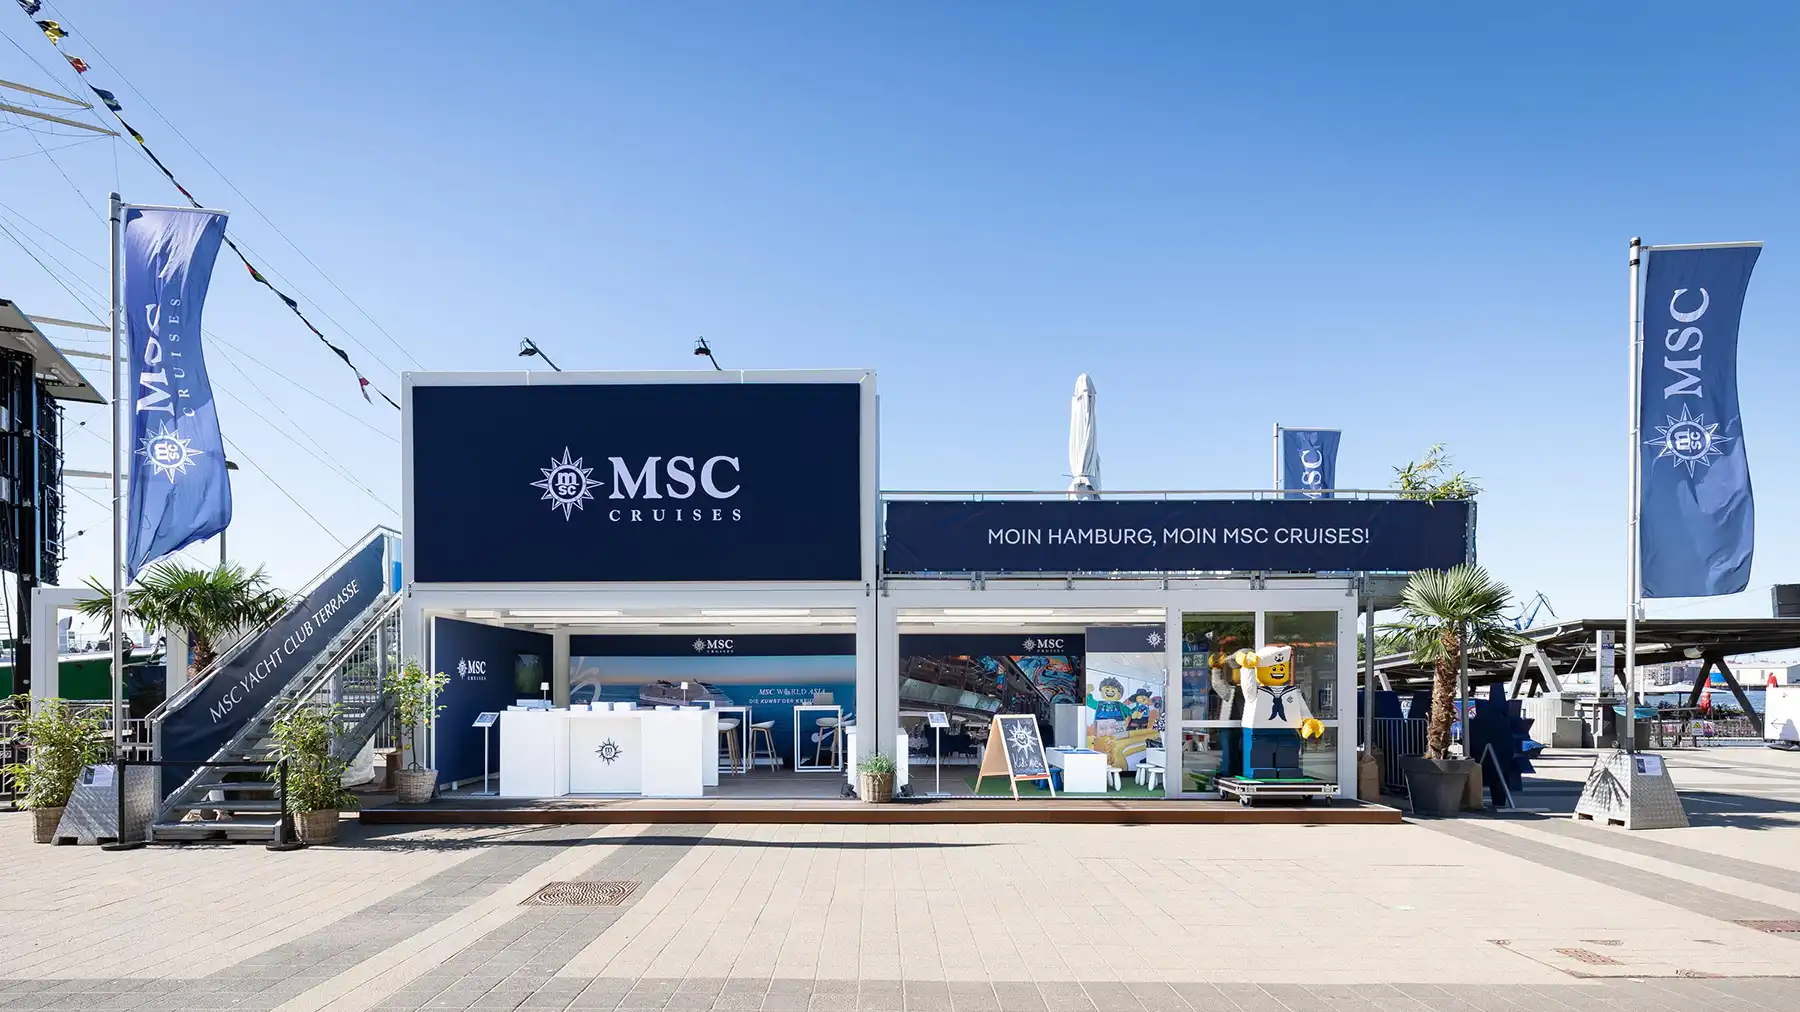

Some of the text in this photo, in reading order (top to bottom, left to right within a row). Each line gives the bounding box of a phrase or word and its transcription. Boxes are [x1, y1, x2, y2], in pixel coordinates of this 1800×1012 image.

[1664, 287, 1710, 399] MSC
[168, 298, 196, 417] CRUISES
[608, 455, 741, 499] MSC
[608, 508, 741, 522] CRUISES
[987, 528, 1371, 548] MOIN HAMBURG, MOIN MSC CRUISES!
[208, 579, 360, 724] MSC YACHT CLUB TERRASSE
[706, 639, 734, 649] MSC
[1037, 639, 1064, 649] MSC
[467, 660, 487, 674] MSC
